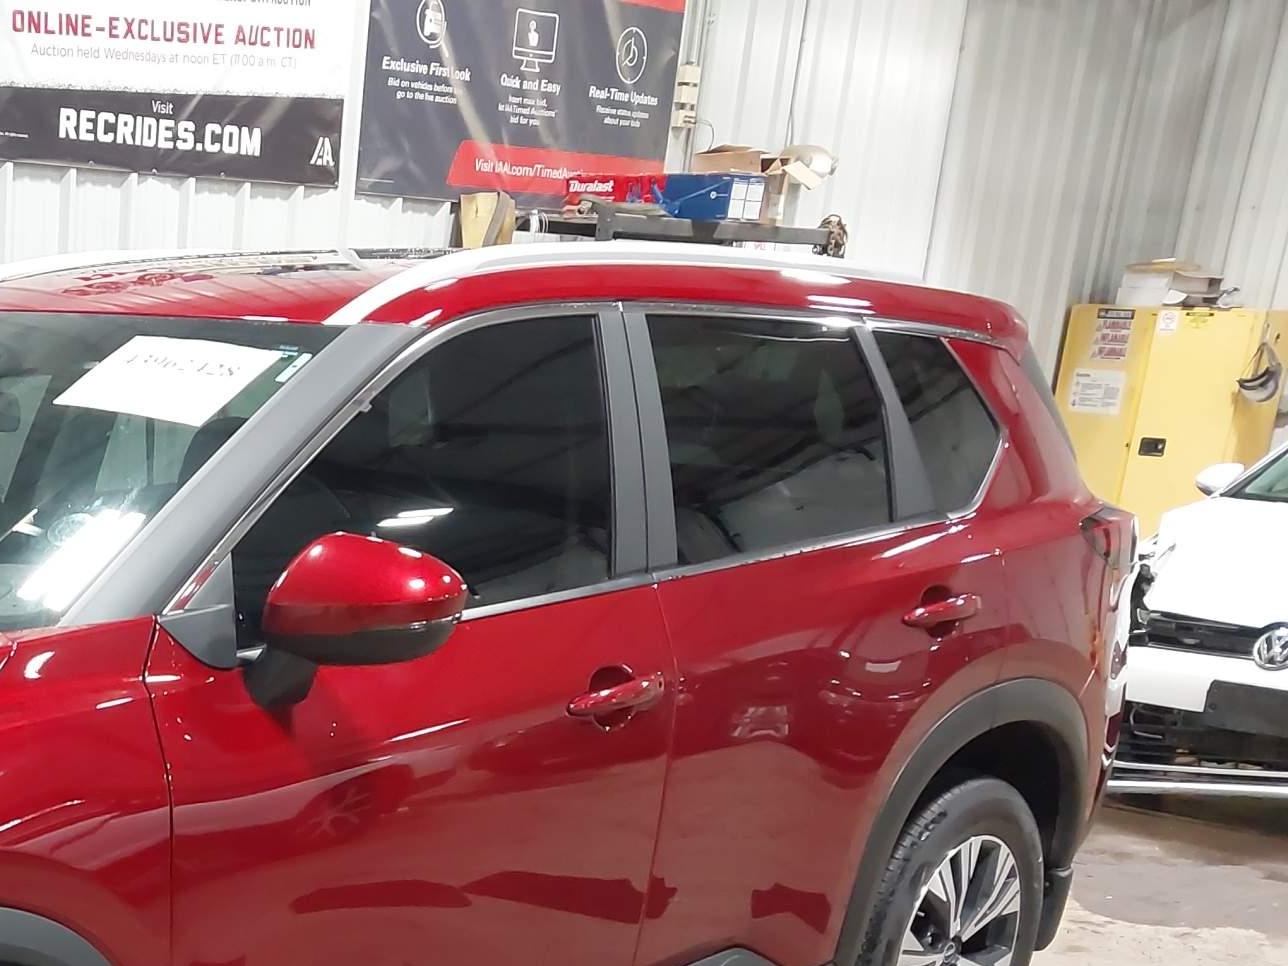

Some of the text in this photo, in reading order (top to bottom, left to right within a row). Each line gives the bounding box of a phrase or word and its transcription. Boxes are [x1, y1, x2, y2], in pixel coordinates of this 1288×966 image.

[12, 9, 316, 49] ONLINE-EXCLUSIVE AUCTION
[31, 42, 74, 58] Auction
[77, 45, 101, 59] held
[104, 47, 166, 65] Wednesdays
[183, 54, 210, 65] noon
[382, 56, 428, 75] Exclusive
[429, 62, 451, 78] First
[500, 74, 561, 96] Quick and Easy
[588, 85, 658, 106] Real-Time Updates
[152, 100, 175, 115] Visit
[58, 107, 262, 158] RECRIDES.COM
[475, 158, 493, 173] Visit
[568, 179, 615, 193] Duralast
